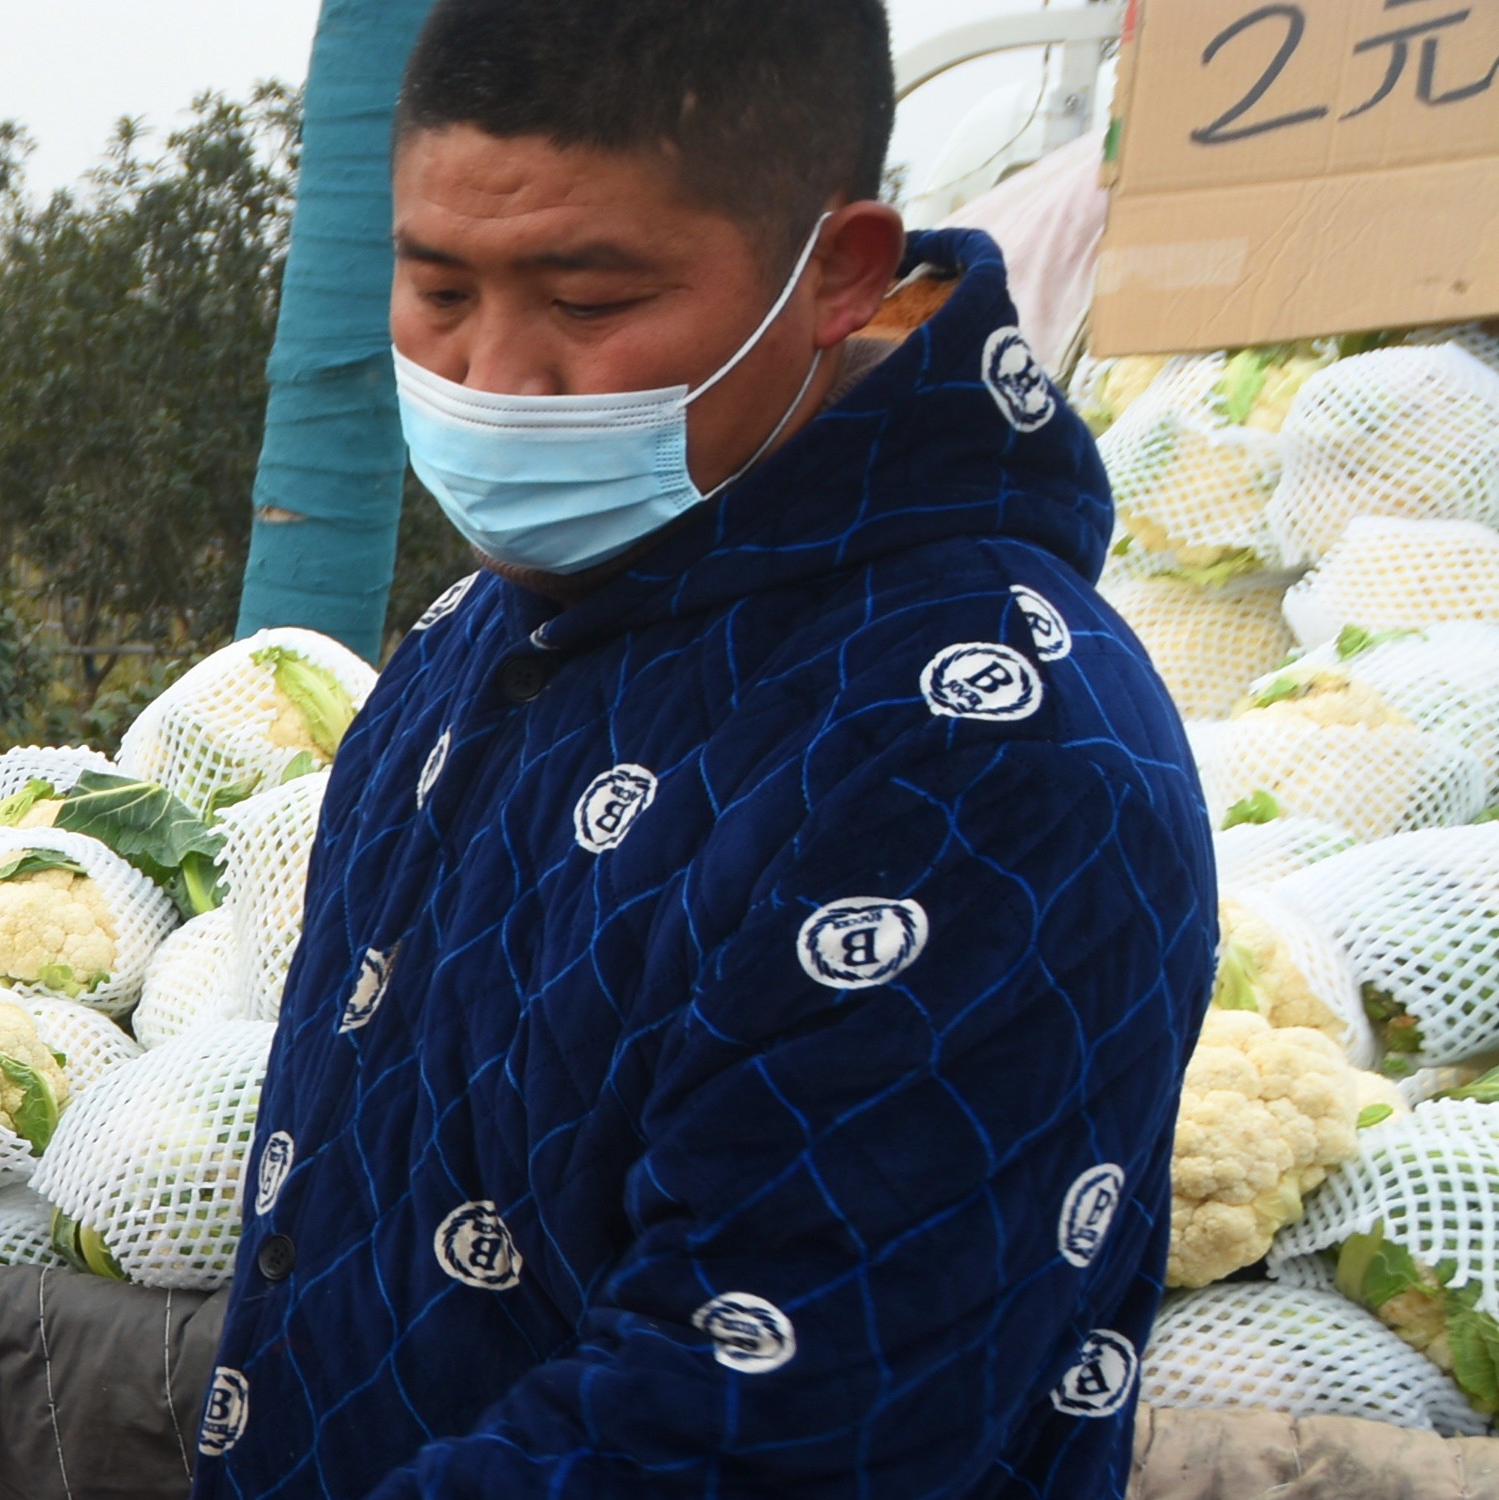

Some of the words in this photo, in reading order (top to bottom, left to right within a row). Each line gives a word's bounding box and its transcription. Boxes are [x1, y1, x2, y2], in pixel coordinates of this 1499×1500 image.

[963, 660, 1014, 694] B
[595, 800, 632, 833] B
[841, 926, 881, 967] B
[468, 1236, 502, 1271] B
[1076, 1359, 1111, 1396] B
[207, 1387, 232, 1421] B
